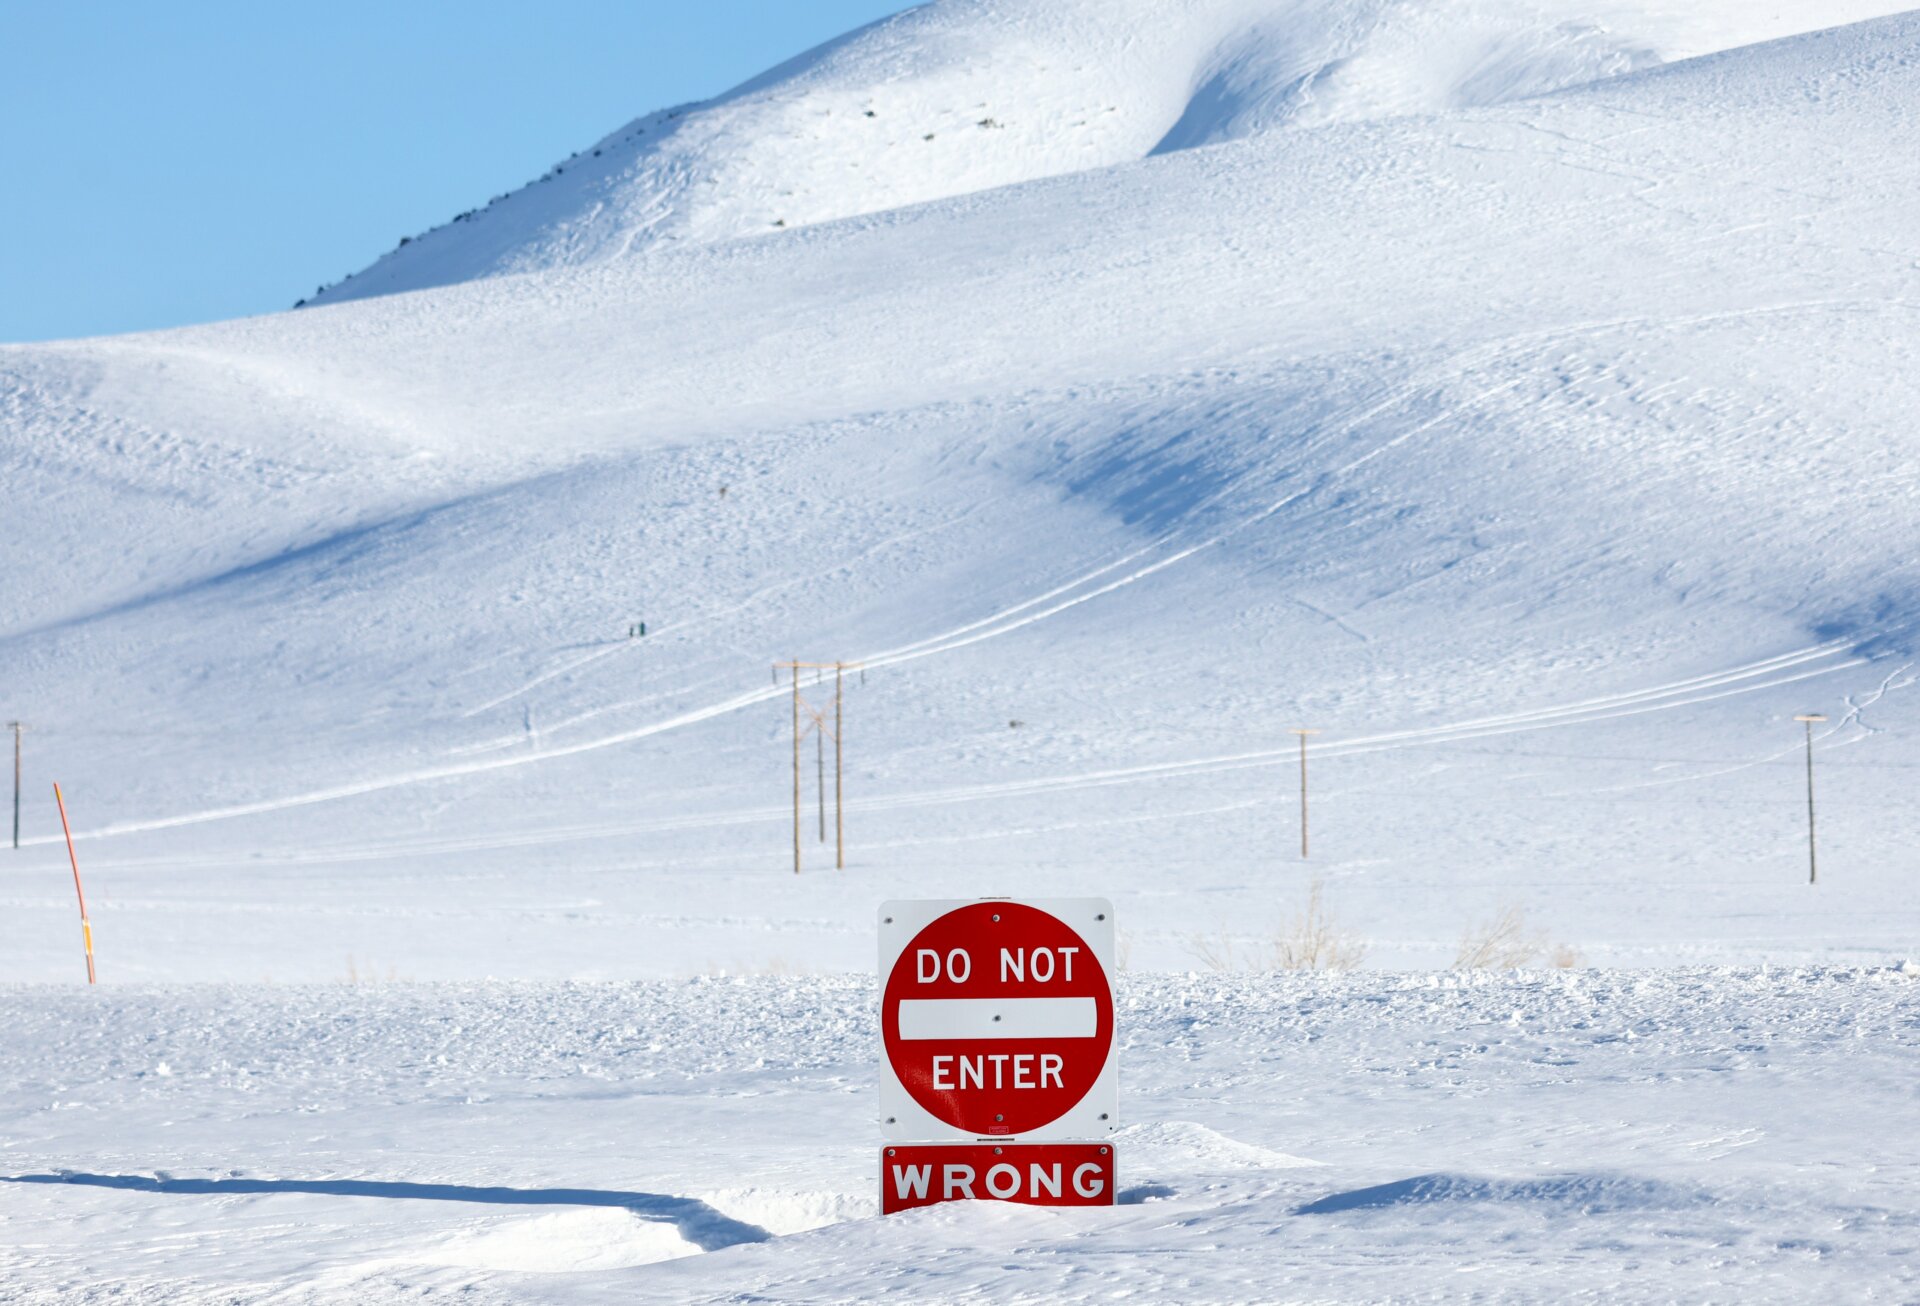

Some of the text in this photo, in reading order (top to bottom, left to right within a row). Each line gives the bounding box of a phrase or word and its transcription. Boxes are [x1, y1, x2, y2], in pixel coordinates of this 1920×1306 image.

[916, 947, 1080, 984] DO NOT
[932, 1054, 1065, 1091] ENTER
[891, 1162, 1105, 1200] WRONG
